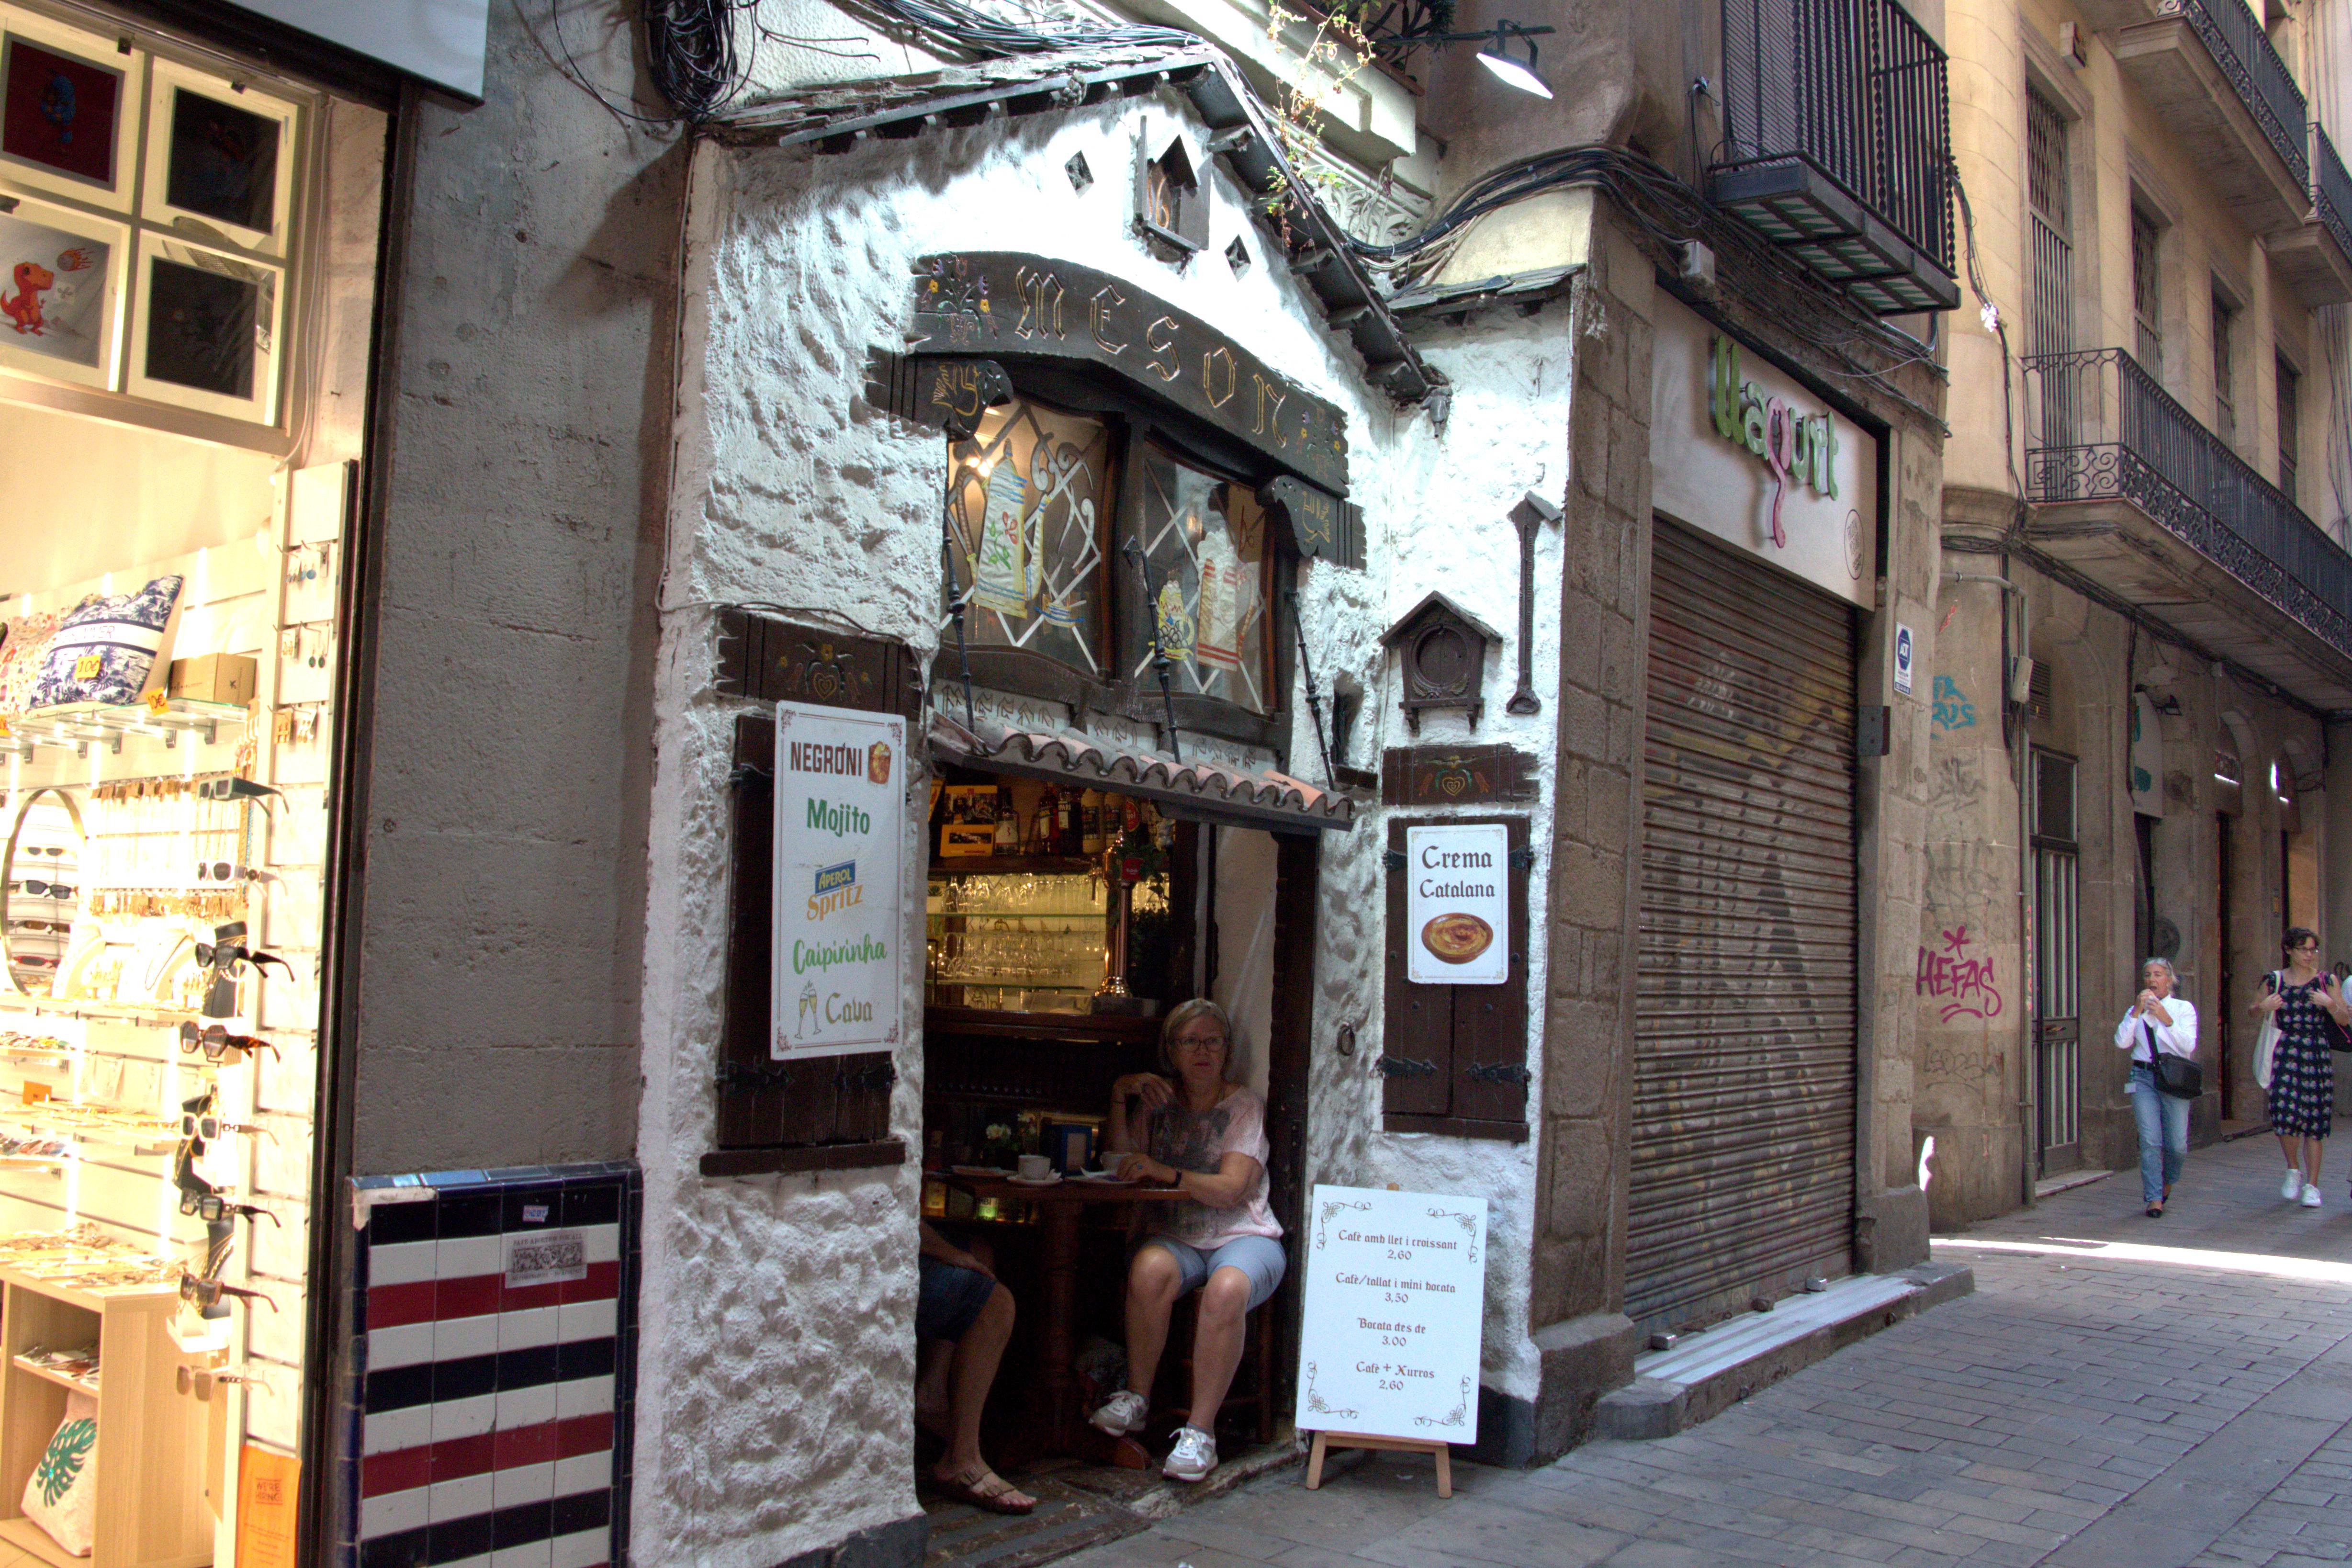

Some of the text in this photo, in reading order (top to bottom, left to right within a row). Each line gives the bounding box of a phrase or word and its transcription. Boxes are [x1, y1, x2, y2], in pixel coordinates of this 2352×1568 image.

[1014, 265, 1287, 448] MESON
[791, 741, 862, 777] NEGRONI
[807, 797, 870, 837] Mojito
[1422, 845, 1493, 869] Crema
[818, 867, 853, 890] APEROL
[1420, 879, 1495, 898] Catalana
[807, 884, 864, 922] Spritz
[793, 933, 888, 975] Caipirinha
[1915, 945, 2003, 1017] HEFAS
[825, 992, 873, 1025] Cava
[1339, 1230, 1457, 1250] Cafè amb llet i croissant
[1336, 1272, 1456, 1293] Cafè/tallat i mini bocata
[1357, 1317, 1426, 1334] Bocata des de
[1383, 1363, 1392, 1372] +
[1395, 1365, 1435, 1379] Xurros
